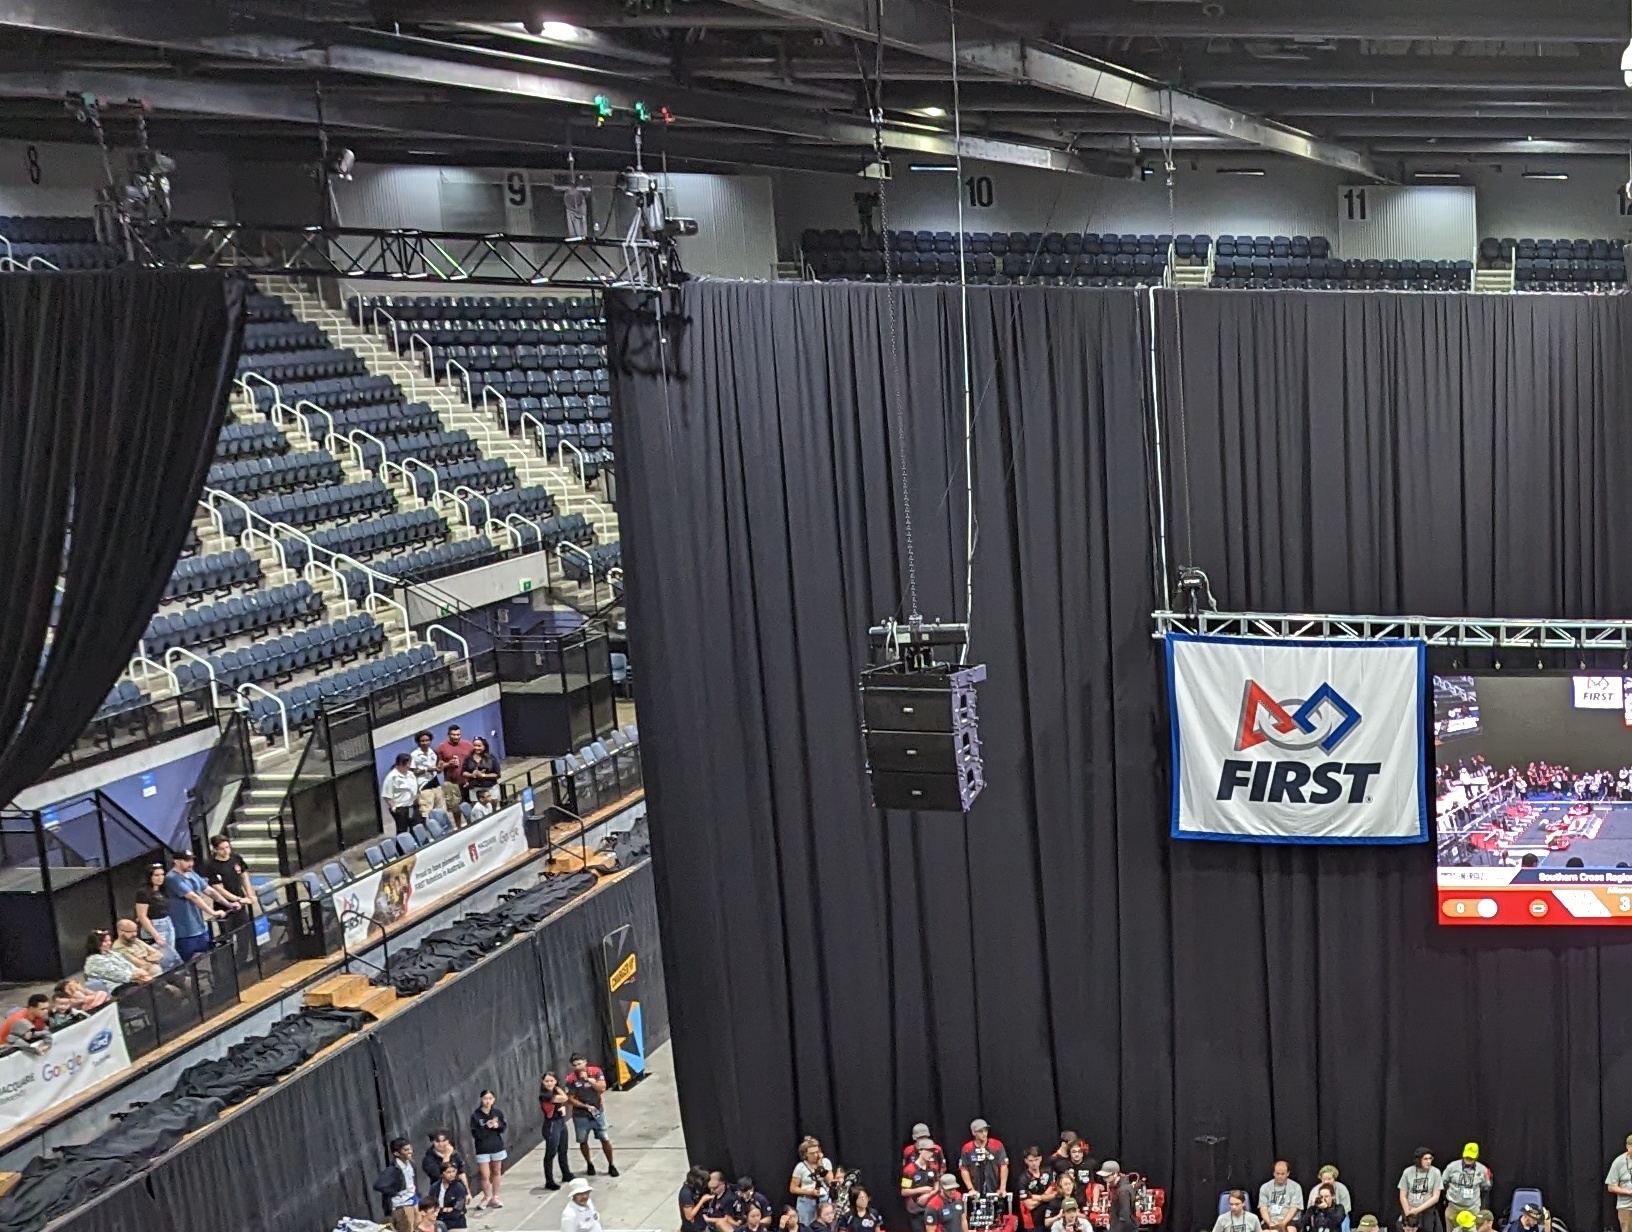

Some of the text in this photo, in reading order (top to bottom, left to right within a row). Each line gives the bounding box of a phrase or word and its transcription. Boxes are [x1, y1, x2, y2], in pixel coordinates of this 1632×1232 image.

[26, 144, 42, 186] 8
[506, 171, 527, 207] 9
[965, 176, 994, 208] 10
[1344, 188, 1366, 220] 11
[1583, 692, 1615, 701] FIRST
[1216, 759, 1382, 804] FIRST
[1618, 896, 1632, 912] 3
